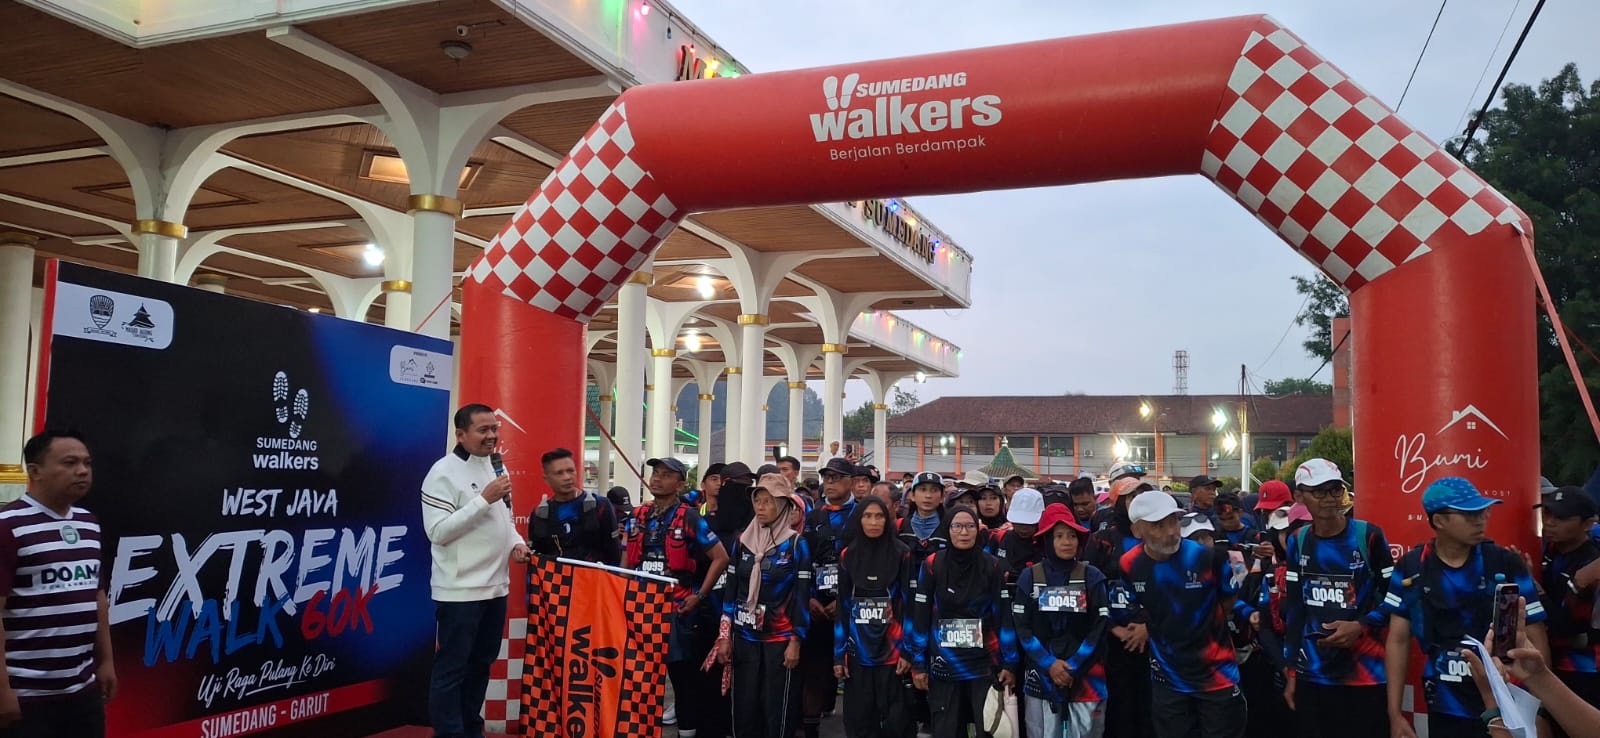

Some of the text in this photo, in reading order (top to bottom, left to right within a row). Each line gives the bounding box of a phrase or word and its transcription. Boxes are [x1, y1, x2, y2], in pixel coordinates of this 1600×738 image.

[856, 71, 967, 98] SUMEDANG
[809, 94, 1002, 142] walkers
[830, 135, 986, 161] Berjalan Berdampak
[863, 199, 935, 264] SUMEDANG
[256, 436, 318, 451] SUMEDANG
[252, 451, 319, 470] walkers
[1394, 432, 1489, 494] Bumi
[222, 488, 338, 517] WEST JAVA
[108, 525, 408, 625] EXTREME
[642, 560, 664, 572] 0099
[1049, 595, 1077, 608] 0045
[1312, 587, 1344, 603] 0046
[144, 583, 380, 667] WALK 60K
[860, 608, 883, 620] 0047
[947, 630, 973, 643] 0055
[197, 653, 336, 708] Uji Raga Pulang Ke Diri
[1448, 660, 1472, 676] 00
[201, 704, 277, 738] SUMEDANG
[290, 692, 330, 720] GARUT
